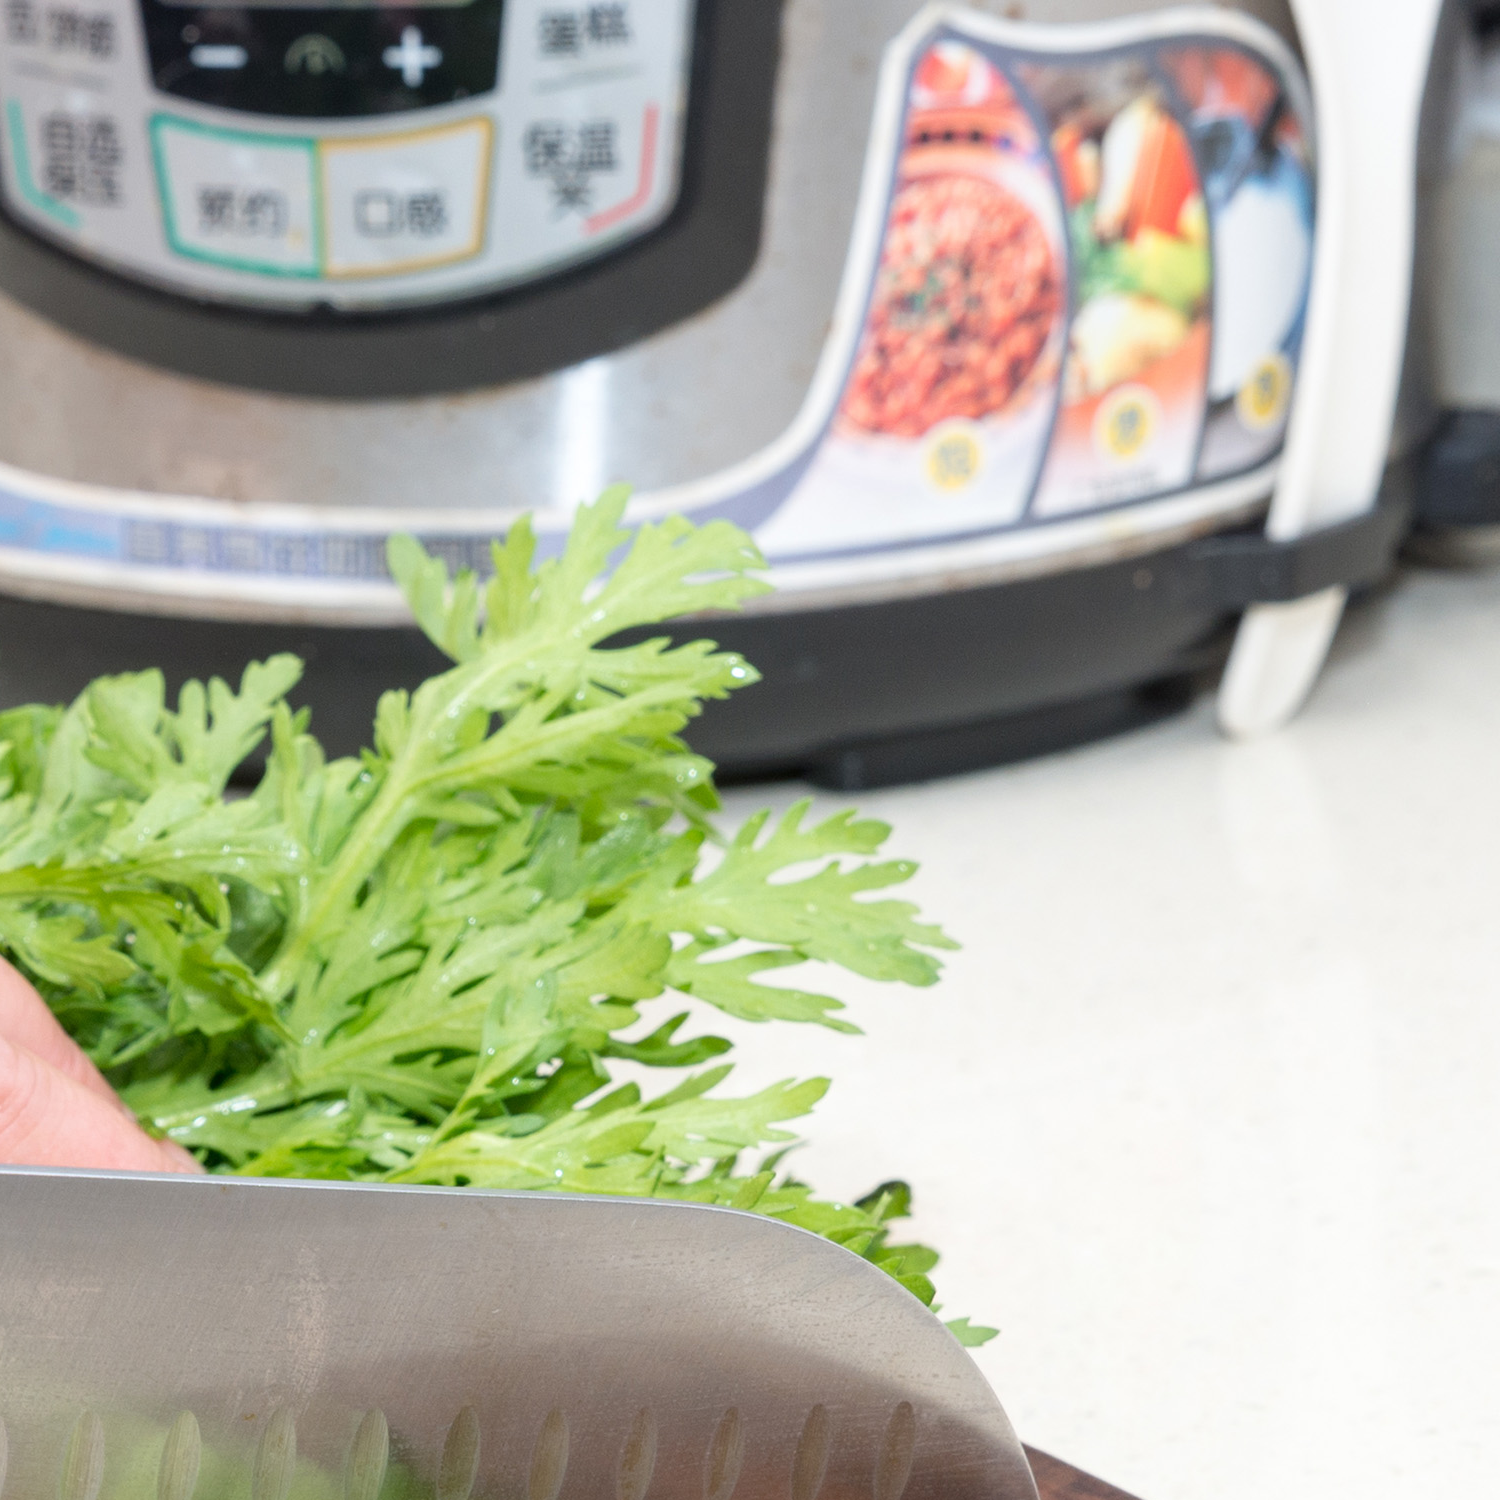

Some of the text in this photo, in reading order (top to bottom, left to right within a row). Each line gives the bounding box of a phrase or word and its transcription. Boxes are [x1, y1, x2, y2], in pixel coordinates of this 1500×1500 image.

[525, 121, 615, 174] 保温
[201, 187, 287, 238] 预约
[355, 189, 446, 238] 口感
